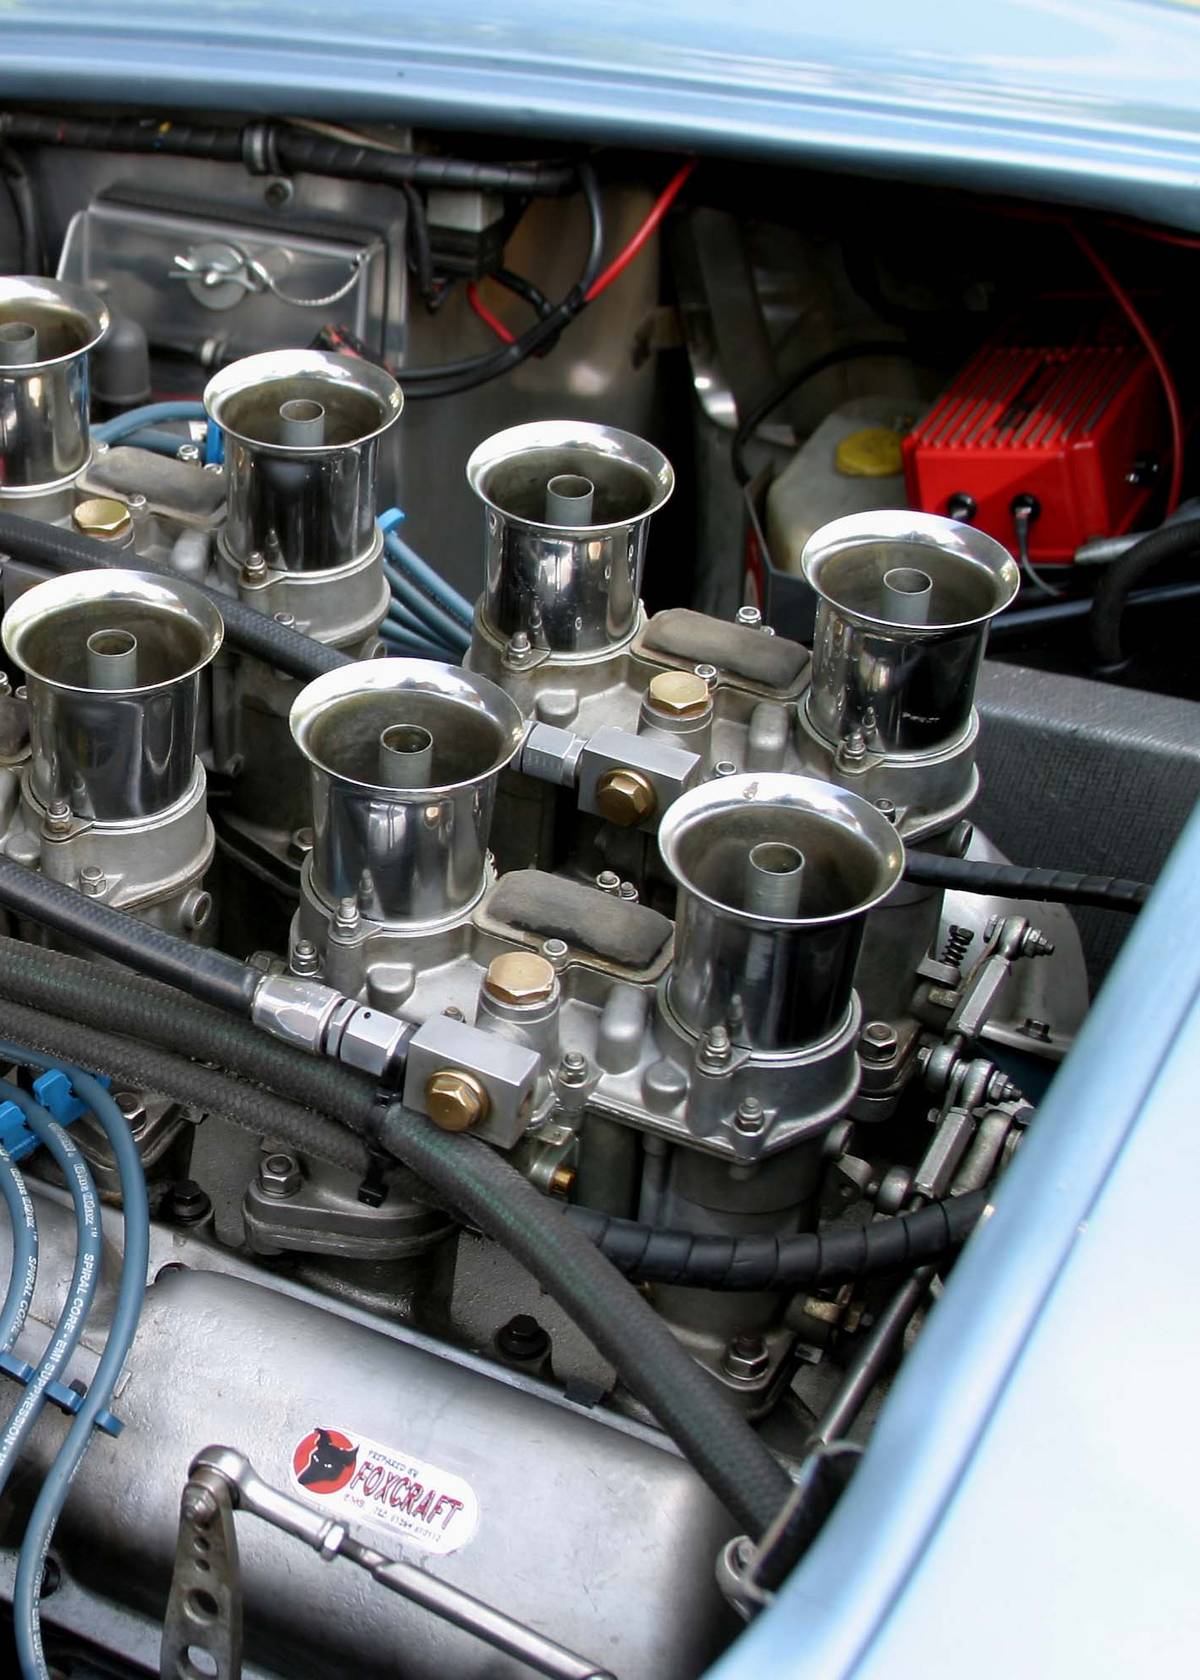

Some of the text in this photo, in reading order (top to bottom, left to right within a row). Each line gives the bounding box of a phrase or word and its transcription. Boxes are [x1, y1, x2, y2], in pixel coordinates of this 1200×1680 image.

[23, 1255, 38, 1298] SPIRAL
[76, 1252, 95, 1298] SPIRAL
[63, 1298, 85, 1333] CORE
[48, 1339, 68, 1364] EMI
[2, 1362, 57, 1447] SUPPRESSION
[349, 1460, 465, 1531] FOXCRAFT
